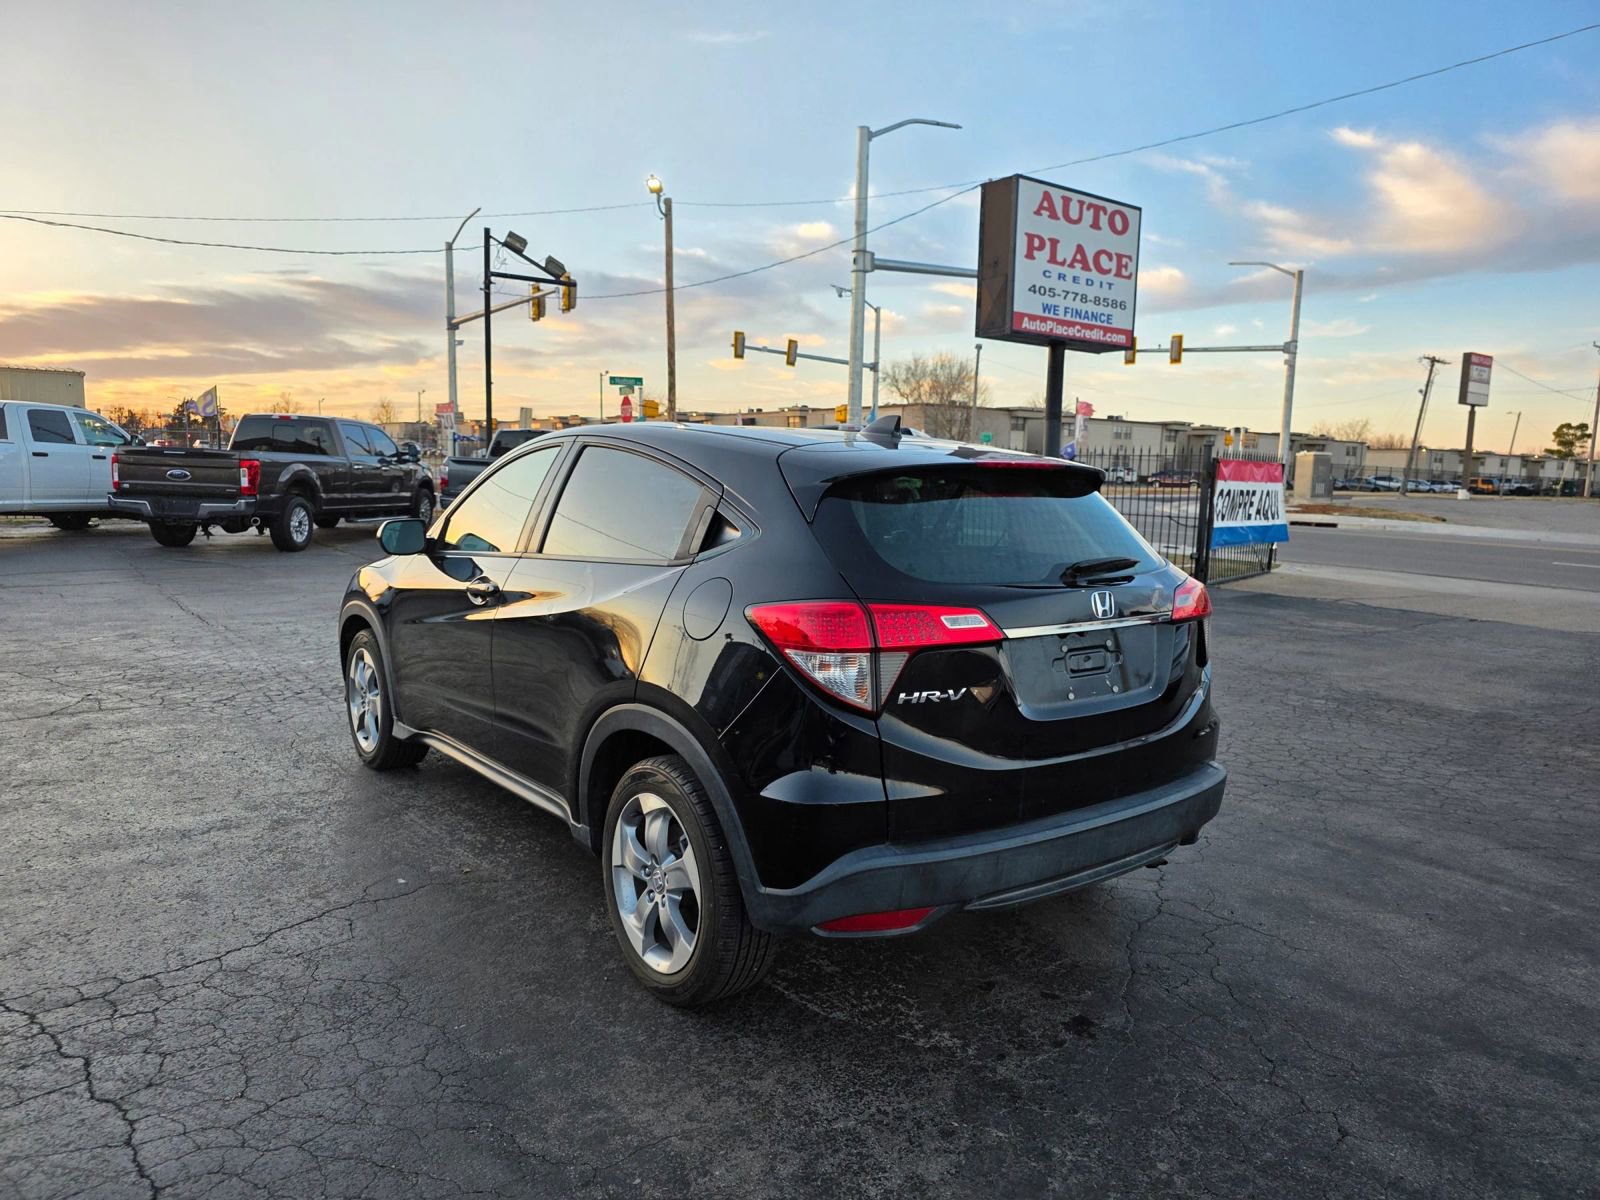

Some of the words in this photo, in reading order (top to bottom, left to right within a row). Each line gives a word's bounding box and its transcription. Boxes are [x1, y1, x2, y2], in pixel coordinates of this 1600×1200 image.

[1033, 190, 1130, 236] AUTO
[1024, 232, 1133, 280] PLACE
[1042, 269, 1115, 290] CREDIT
[1028, 284, 1127, 311] 405-778-8586
[1041, 302, 1060, 317] WE
[1063, 306, 1113, 325] FINANCE
[1021, 316, 1126, 344] AutoPlaceCredit.com
[1215, 489, 1256, 521] COMPRE
[1255, 489, 1279, 521] AQUI
[897, 687, 967, 705] HR-V
